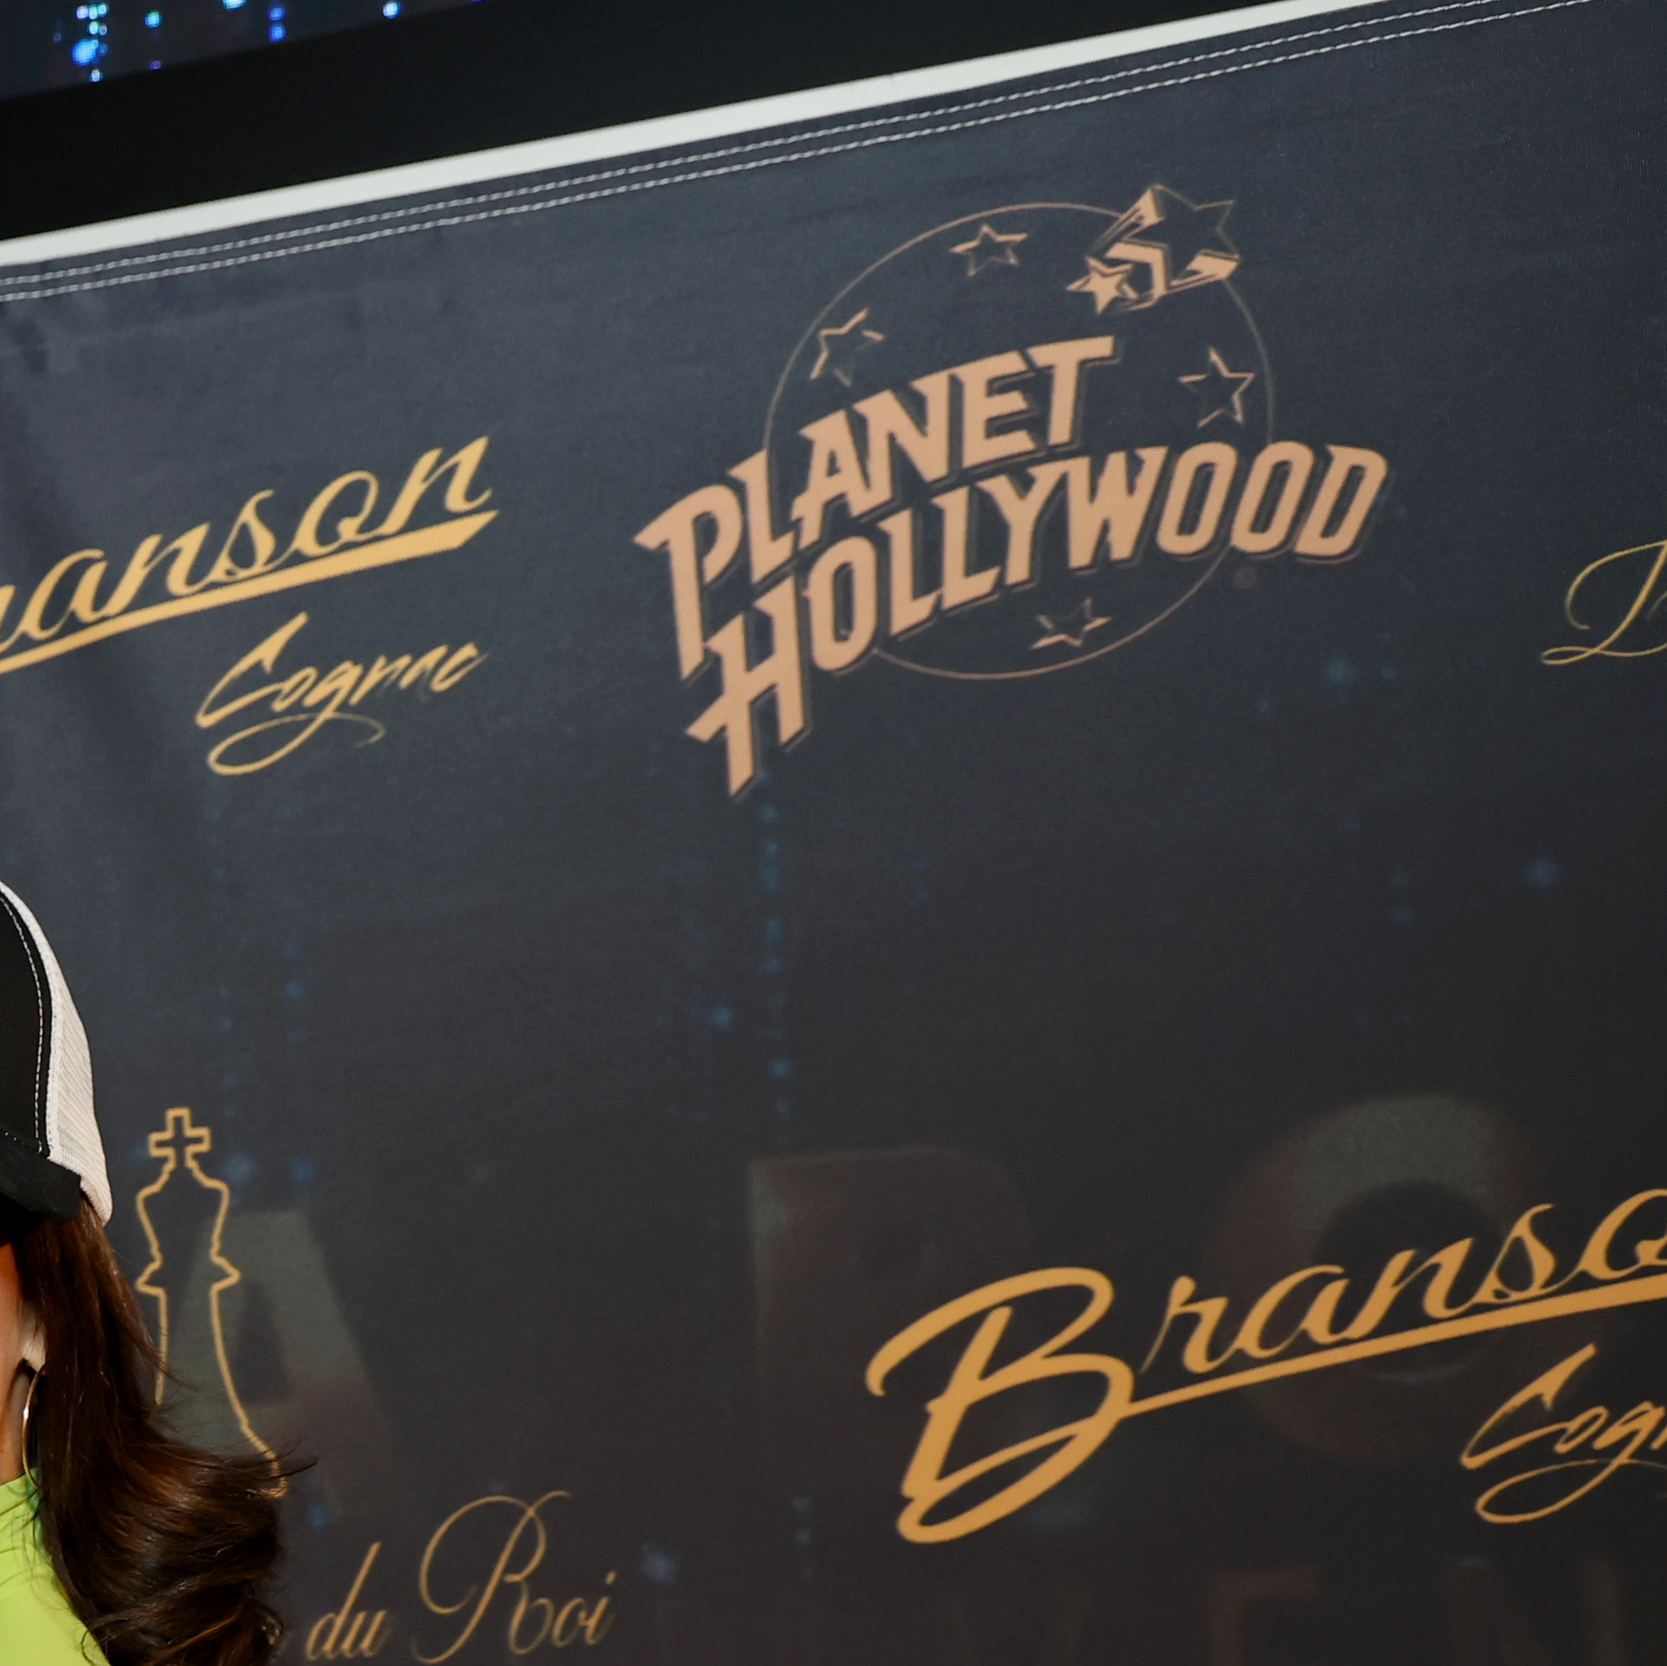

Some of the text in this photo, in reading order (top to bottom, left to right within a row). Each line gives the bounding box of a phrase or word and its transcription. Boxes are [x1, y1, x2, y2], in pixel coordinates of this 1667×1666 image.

[633, 334, 1116, 682] PLANET
[685, 440, 1390, 800] HOLLYWOOD
[1461, 1344, 1667, 1523] Cog
[305, 1490, 616, 1665] du Roi
